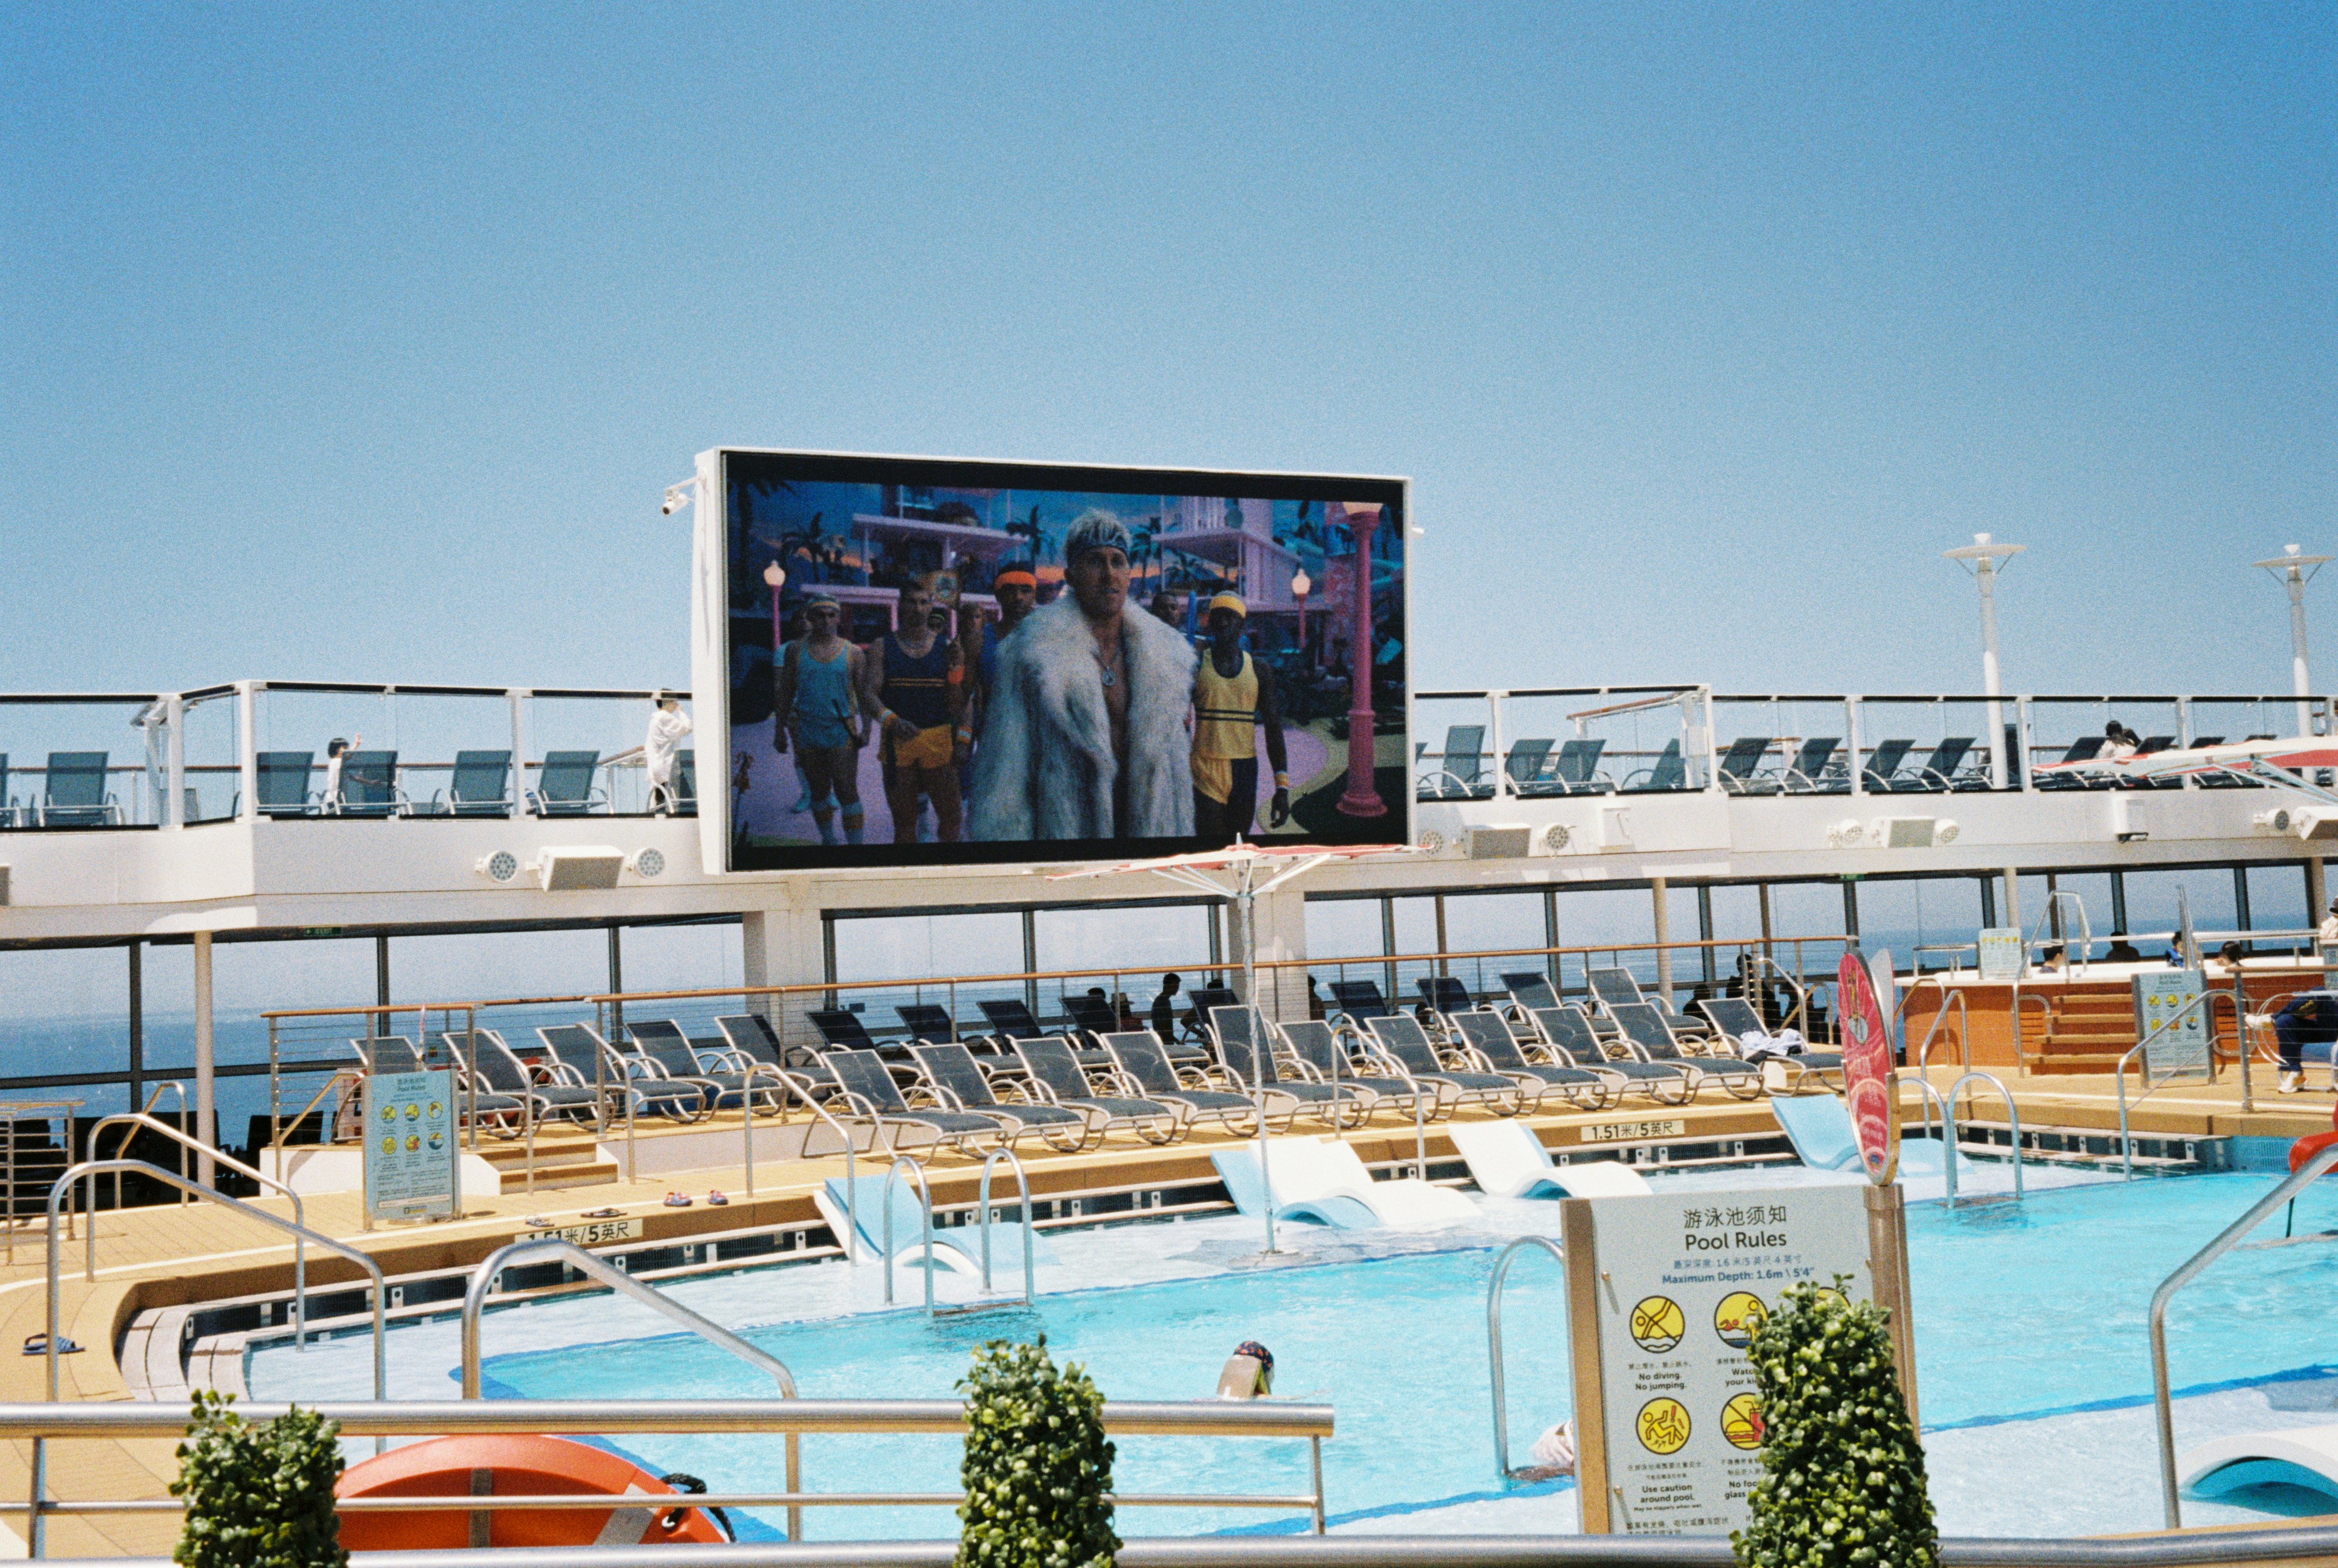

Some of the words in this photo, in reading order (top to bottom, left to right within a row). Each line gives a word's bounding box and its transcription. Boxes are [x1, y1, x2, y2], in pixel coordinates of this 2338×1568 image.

[1683, 1205, 1787, 1229] 游泳池须知
[1685, 1232, 1730, 1251] Pool
[1735, 1231, 1787, 1248] Rules
[1662, 1274, 1715, 1284] Maximum
[1718, 1271, 1754, 1283] Depth:
[1757, 1269, 1783, 1280] 1.6m
[1725, 1379, 1744, 1388] your
[1660, 1484, 1693, 1492] caution
[1640, 1494, 1671, 1503] around
[1725, 1491, 1746, 1500] glass
